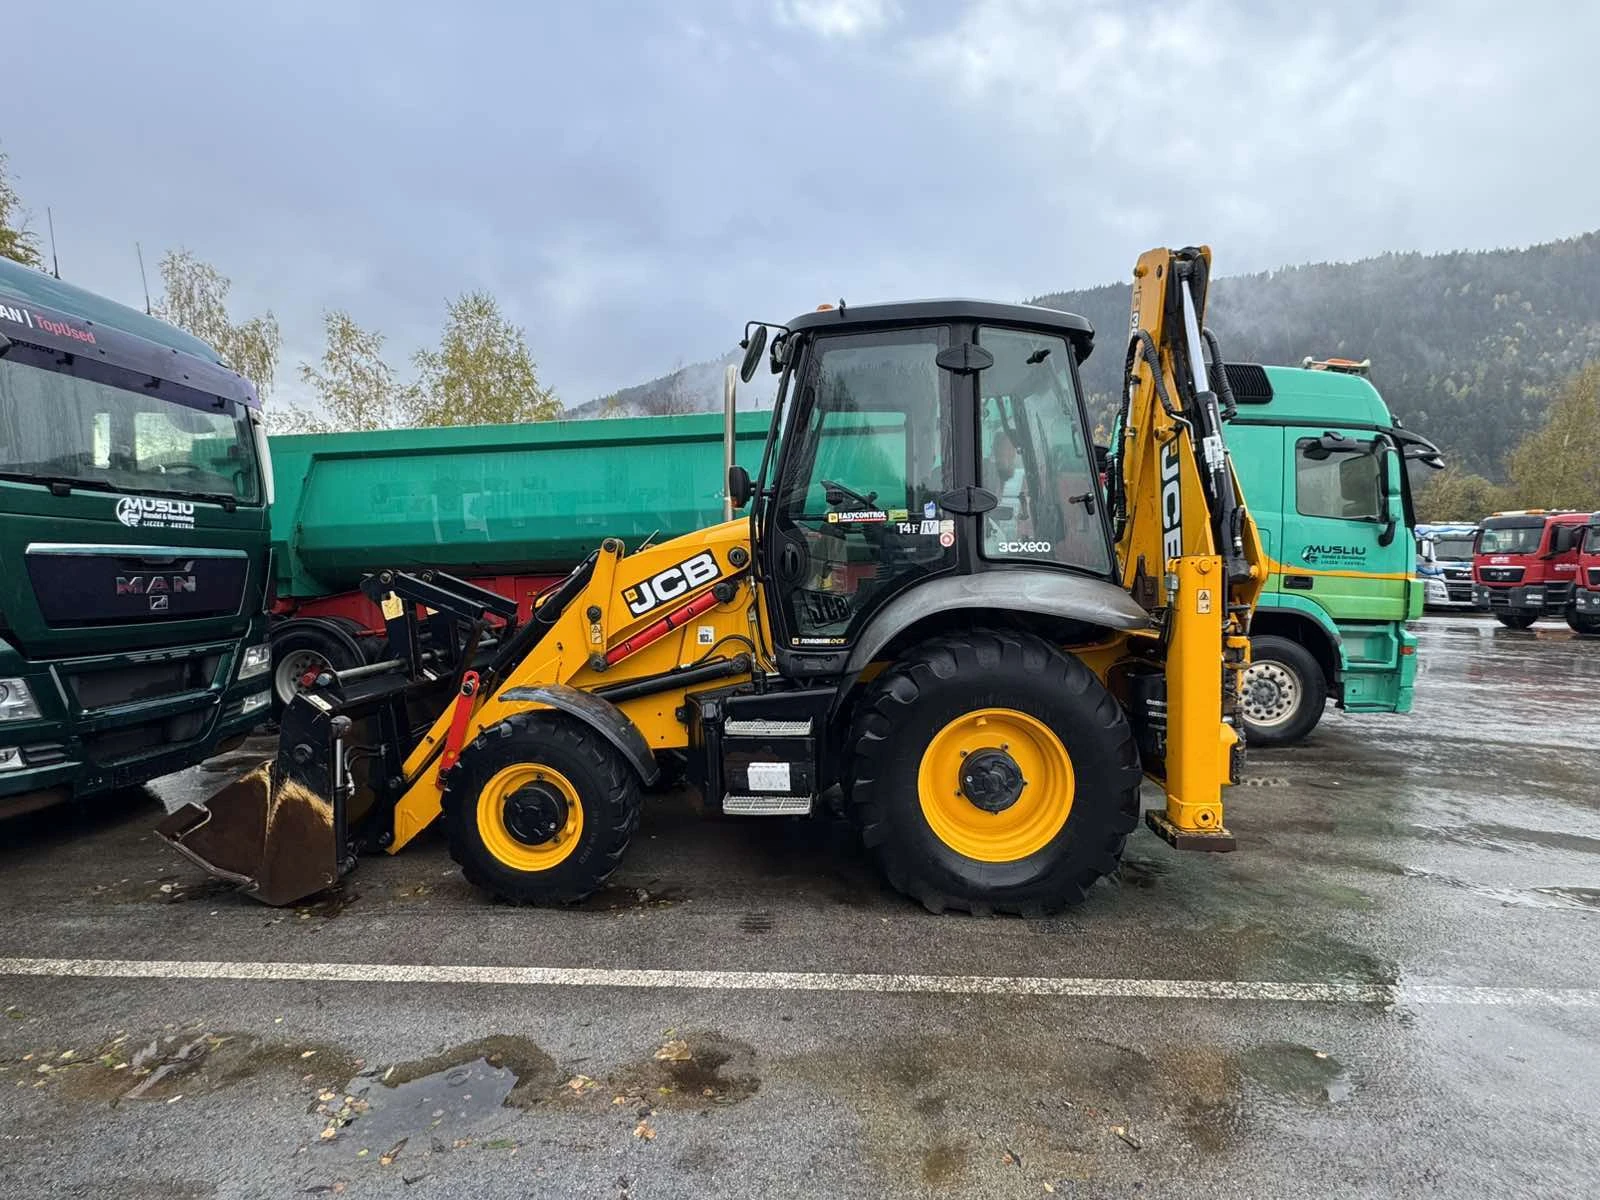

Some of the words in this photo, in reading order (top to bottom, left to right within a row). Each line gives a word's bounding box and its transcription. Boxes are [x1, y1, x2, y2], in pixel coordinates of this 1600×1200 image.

[0, 304, 23, 324] AN
[34, 314, 96, 344] TopUsed
[123, 497, 194, 515] MUSLIU
[838, 511, 887, 520] EASYCONTROL
[1308, 545, 1366, 555] MUSLIU
[116, 576, 196, 593] MAN
[630, 553, 719, 614] JCB
